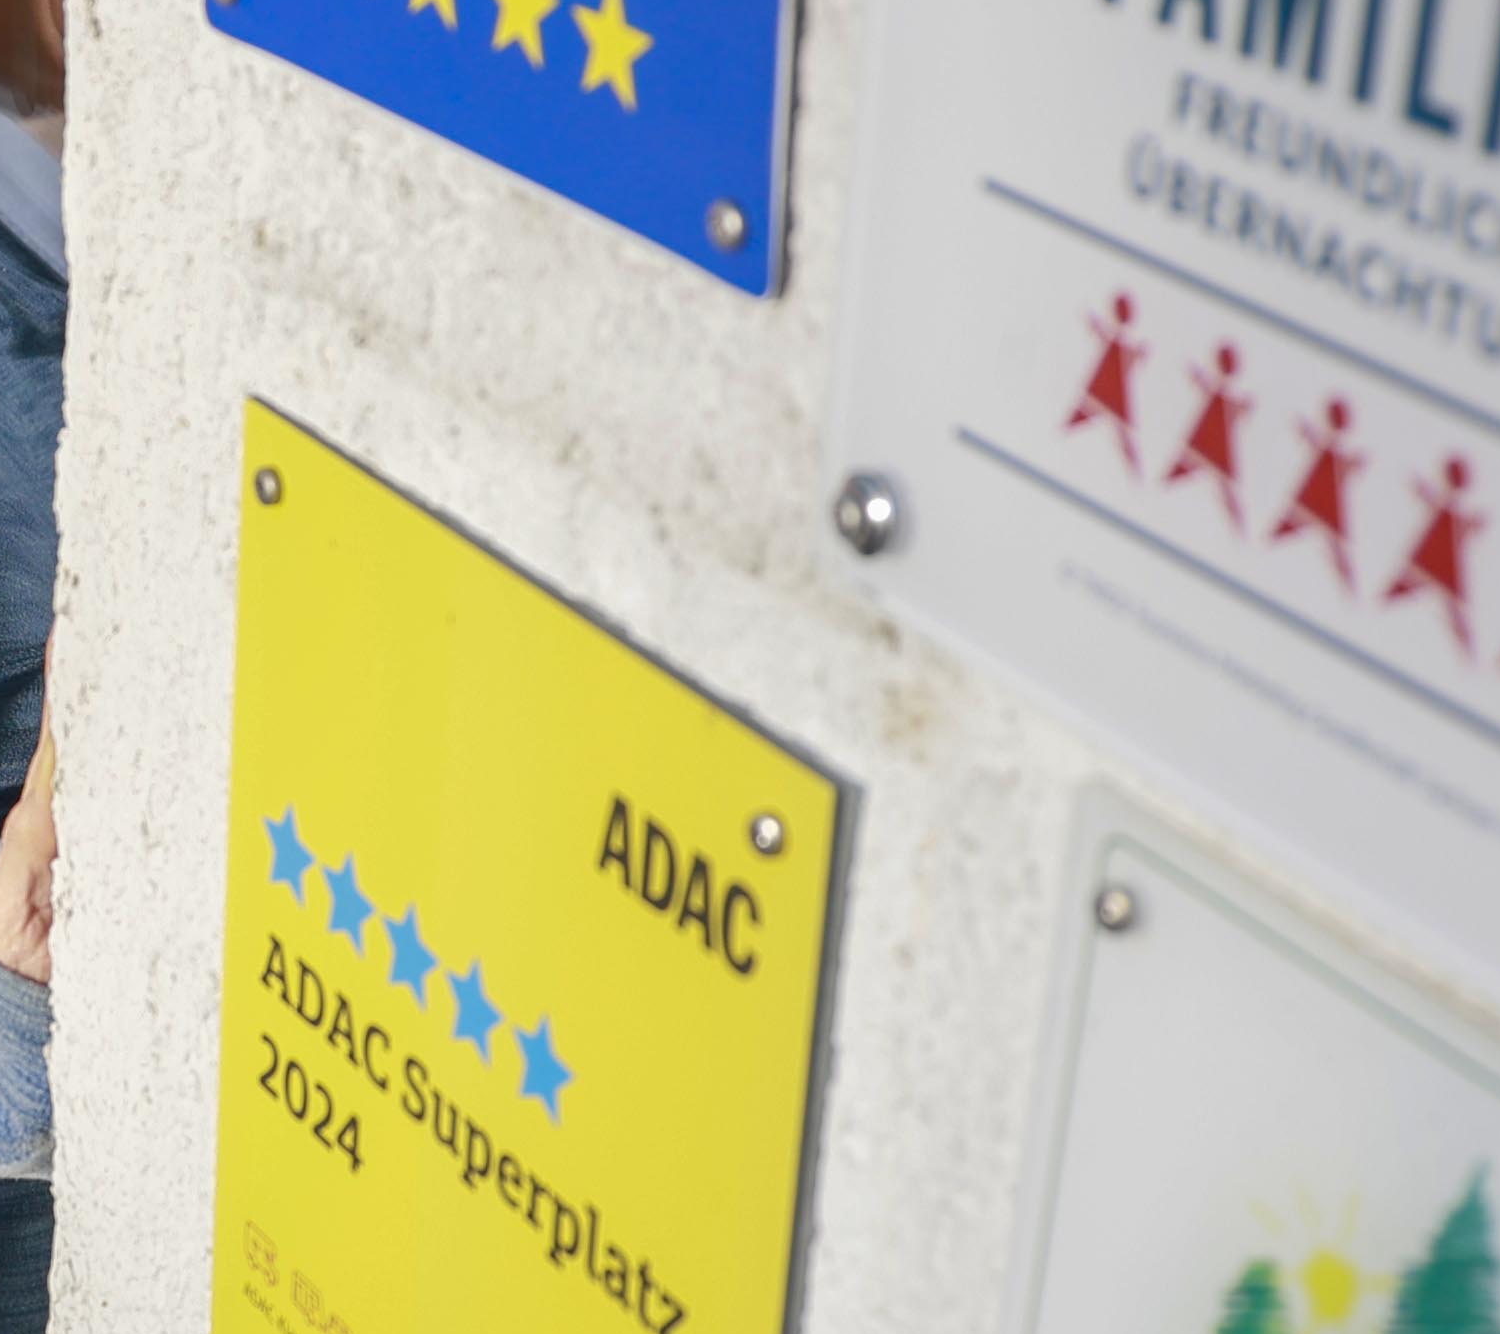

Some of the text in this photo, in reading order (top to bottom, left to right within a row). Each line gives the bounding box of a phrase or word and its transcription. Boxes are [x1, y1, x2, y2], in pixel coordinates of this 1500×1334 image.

[598, 791, 764, 980] ADAC
[257, 933, 391, 1092] ADAC
[257, 1033, 366, 1175] 2024
